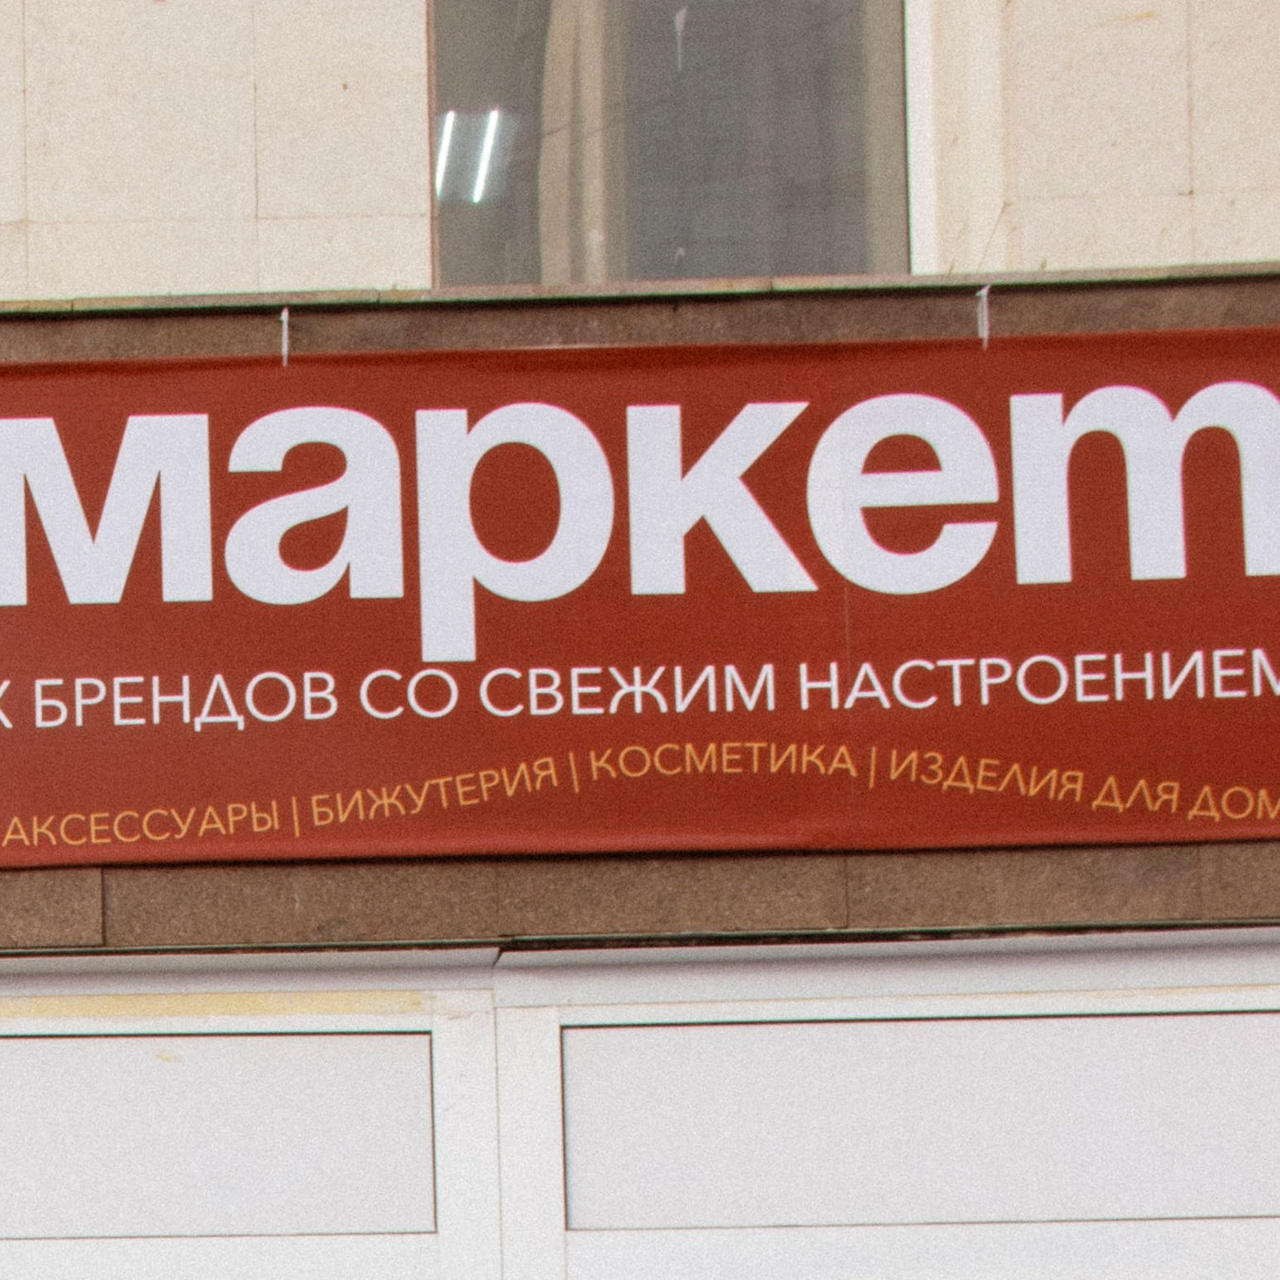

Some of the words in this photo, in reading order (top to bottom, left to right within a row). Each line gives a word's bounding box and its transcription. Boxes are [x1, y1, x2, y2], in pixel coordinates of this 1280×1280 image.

[34, 671, 338, 732] БРЕНДОВ
[359, 668, 459, 720] СО
[479, 663, 775, 717] СВЕЖИМ
[799, 647, 1280, 710] НАСТРОЕНИЕМ
[1, 799, 279, 847] АКСЕССУАРЫ
[310, 757, 558, 827] БИЖУТЕРИЯ
[590, 742, 858, 780] КОСМЕТИКА
[889, 749, 1084, 802] ИЗДЕЛИЯ
[1091, 775, 1180, 813] ДЛЯ
